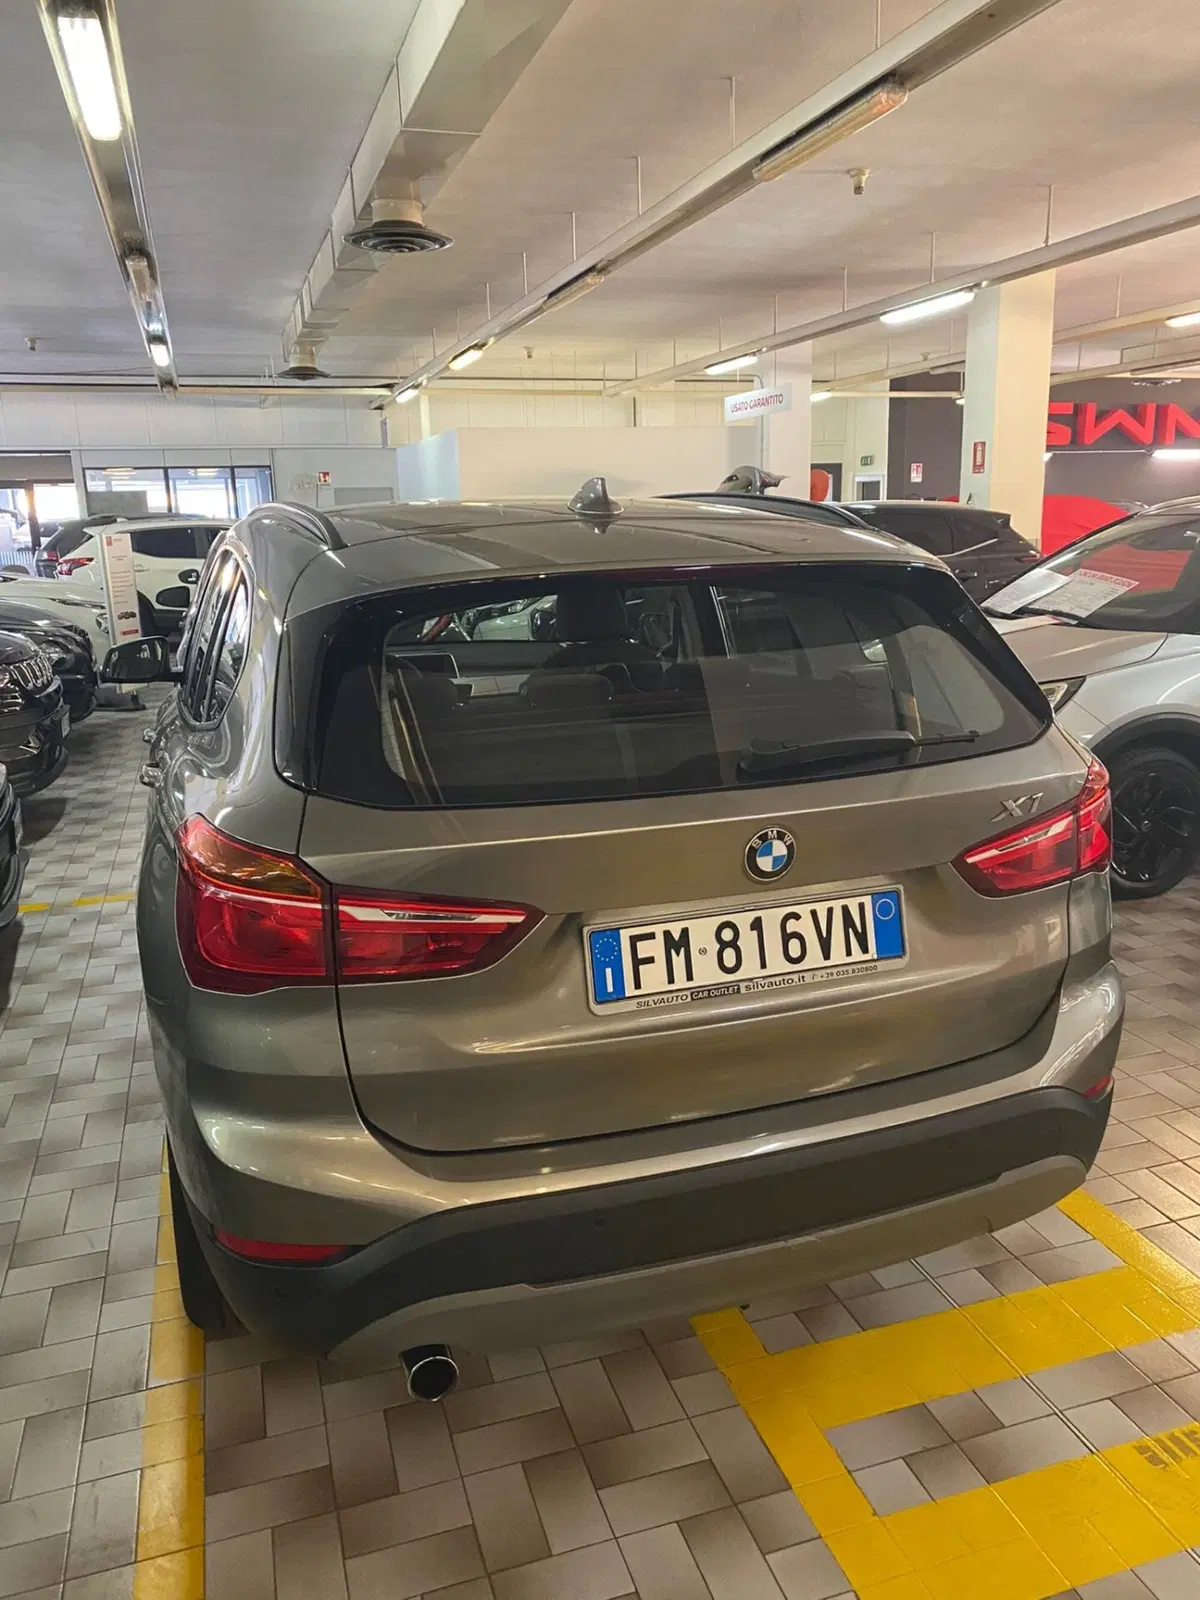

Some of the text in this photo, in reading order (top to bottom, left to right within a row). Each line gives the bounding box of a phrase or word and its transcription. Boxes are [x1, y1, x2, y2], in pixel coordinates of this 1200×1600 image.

[731, 394, 783, 413] USATO GARANTITO
[990, 792, 1044, 823] X1
[752, 830, 794, 849] BMW
[629, 902, 869, 990] FM 816VN
[636, 994, 689, 1009] SILVAUTO
[692, 990, 709, 1000] CAR
[710, 986, 738, 997] OUTLET
[744, 974, 806, 992] silvauto.it
[820, 971, 834, 980] +39
